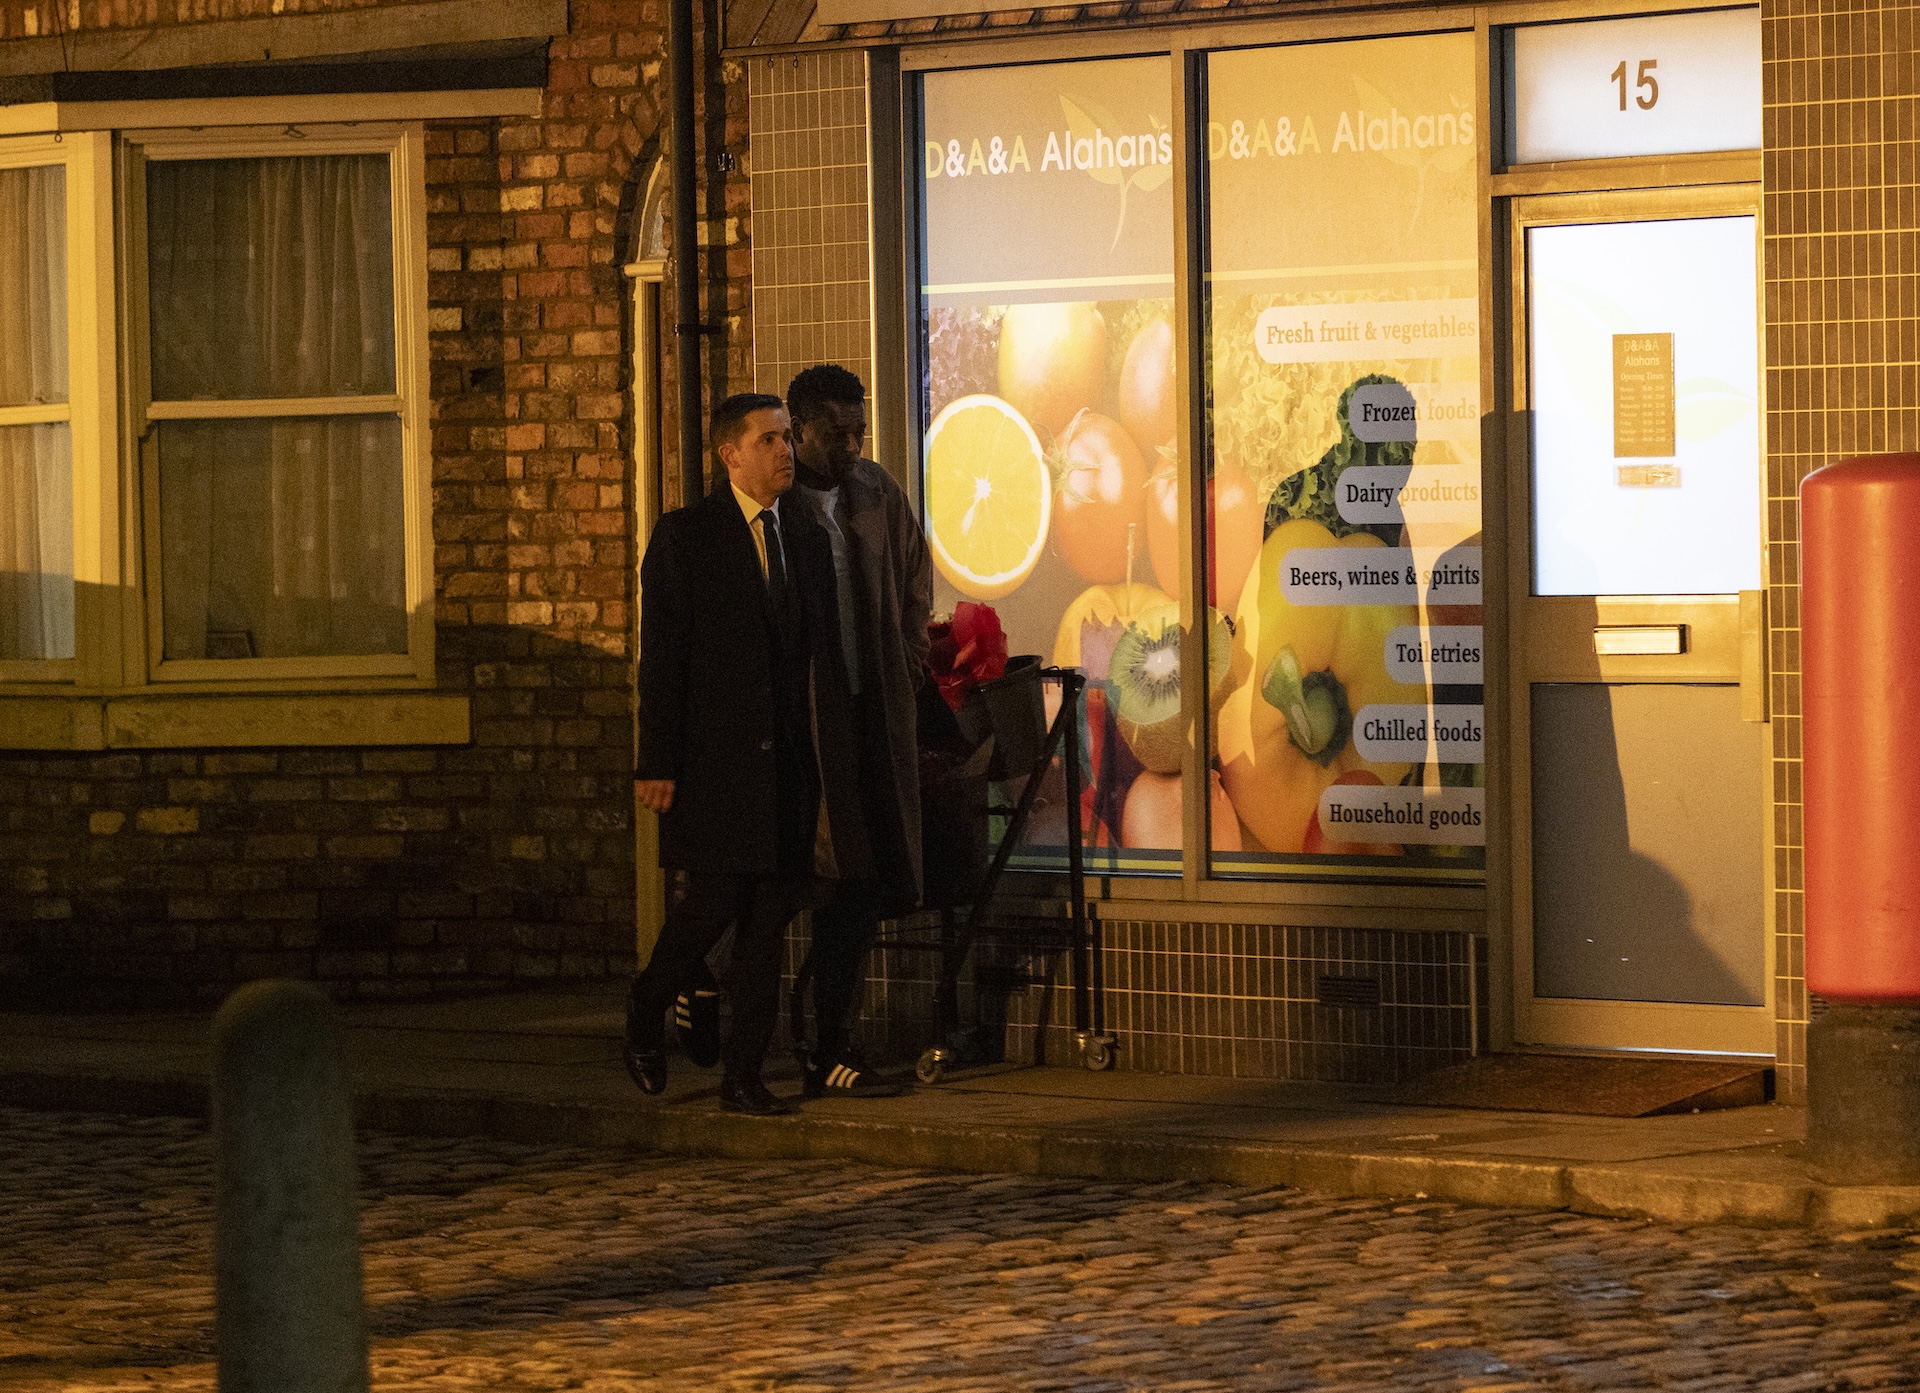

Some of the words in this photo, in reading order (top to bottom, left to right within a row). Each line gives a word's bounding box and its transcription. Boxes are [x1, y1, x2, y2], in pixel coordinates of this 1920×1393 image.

[1610, 59, 1660, 112] 15
[1208, 115, 1321, 162] D&A&A
[924, 134, 1031, 179] D&A&A
[1266, 321, 1314, 345] Fresh
[1319, 320, 1360, 342] fruit
[1365, 321, 1377, 341] &
[1382, 315, 1476, 344] vegetables
[1362, 403, 1421, 422] Frozen
[1427, 398, 1476, 420] foods
[1346, 482, 1394, 507] Dairy
[1399, 480, 1478, 507] products
[1290, 566, 1343, 590] Beers,
[1347, 565, 1399, 586] wines
[1405, 566, 1418, 586] &
[1423, 564, 1480, 590] spirits
[1396, 640, 1481, 663] Toiletries
[1363, 719, 1426, 742] Chilled
[1431, 720, 1482, 742] foods
[1330, 802, 1424, 825] Household
[1429, 804, 1482, 830] goods
